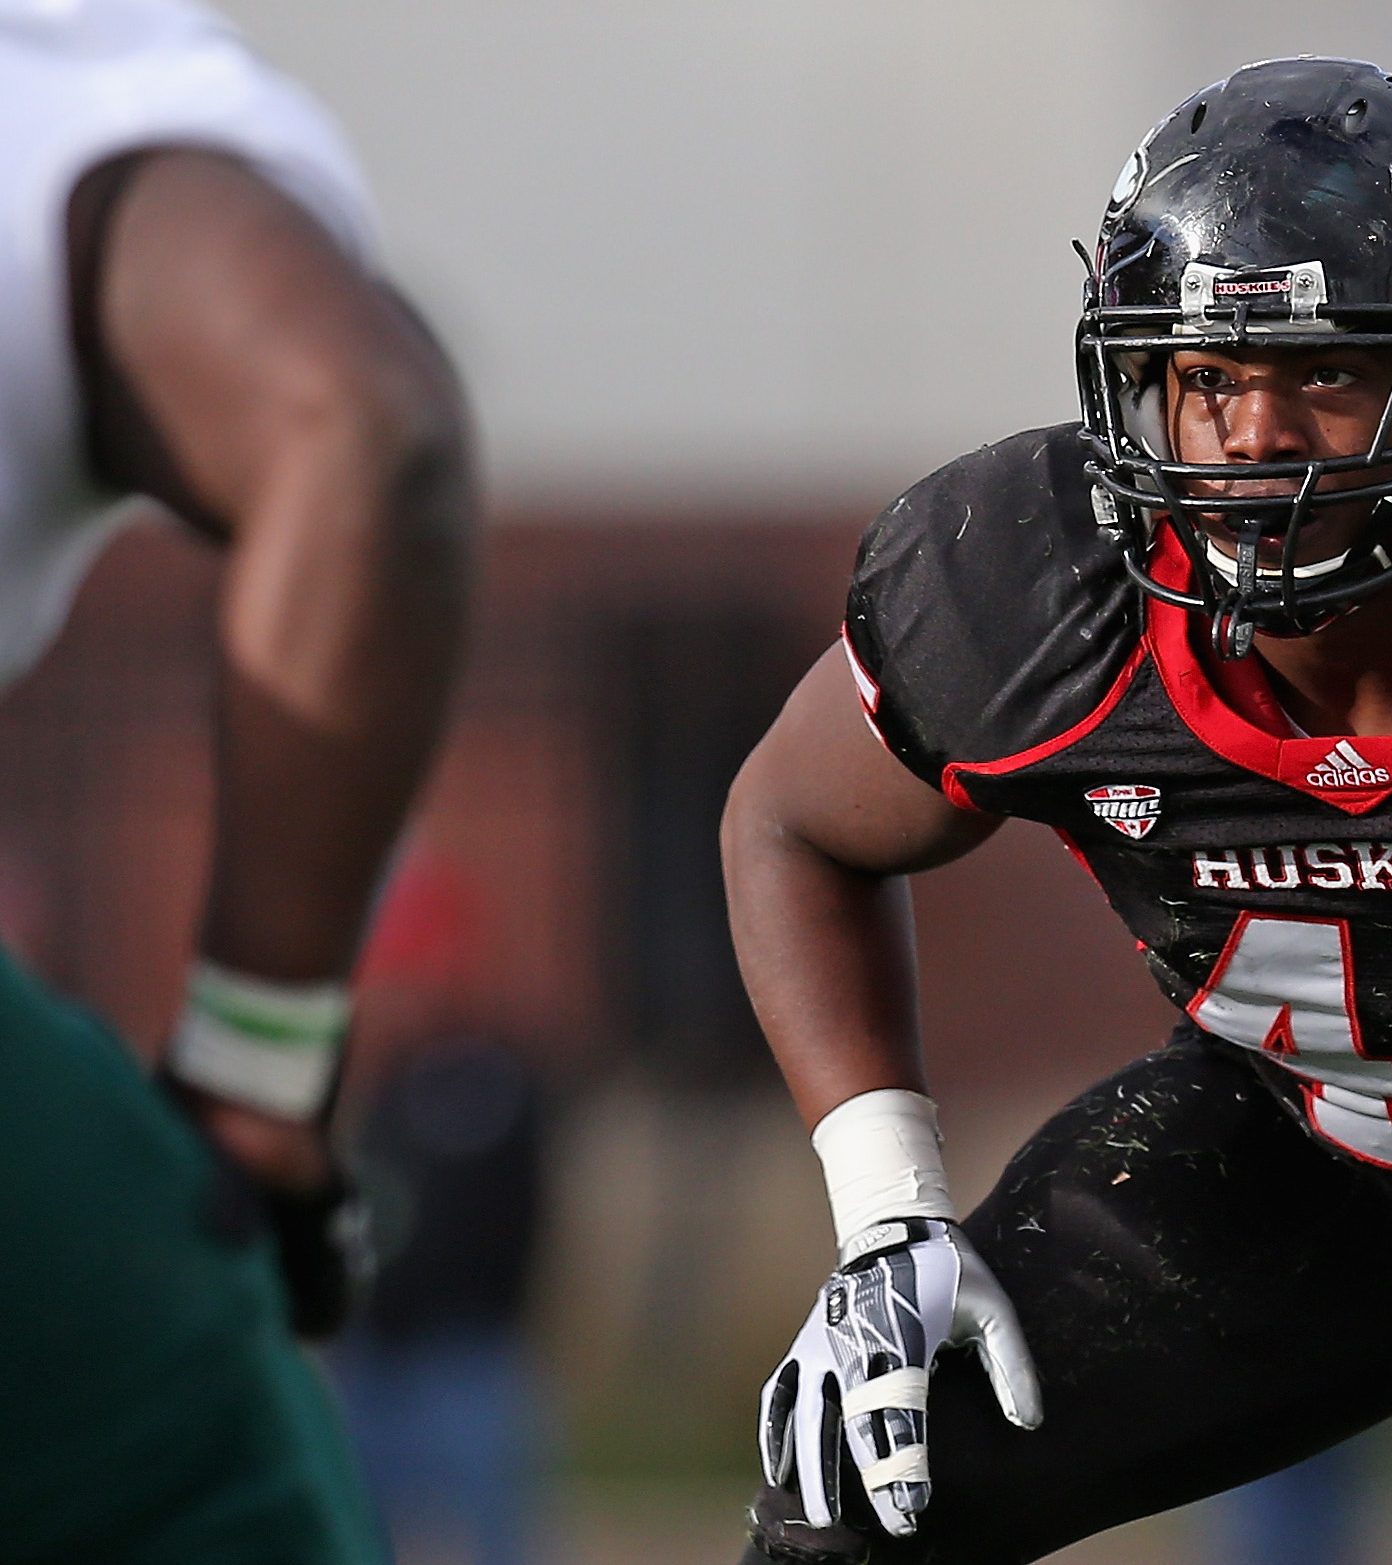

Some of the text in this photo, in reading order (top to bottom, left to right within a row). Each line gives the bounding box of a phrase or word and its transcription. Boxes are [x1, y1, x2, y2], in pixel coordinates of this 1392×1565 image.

[1214, 280, 1292, 295] HUSKIES
[1306, 767, 1390, 787] adidas
[1093, 799, 1162, 818] MAC
